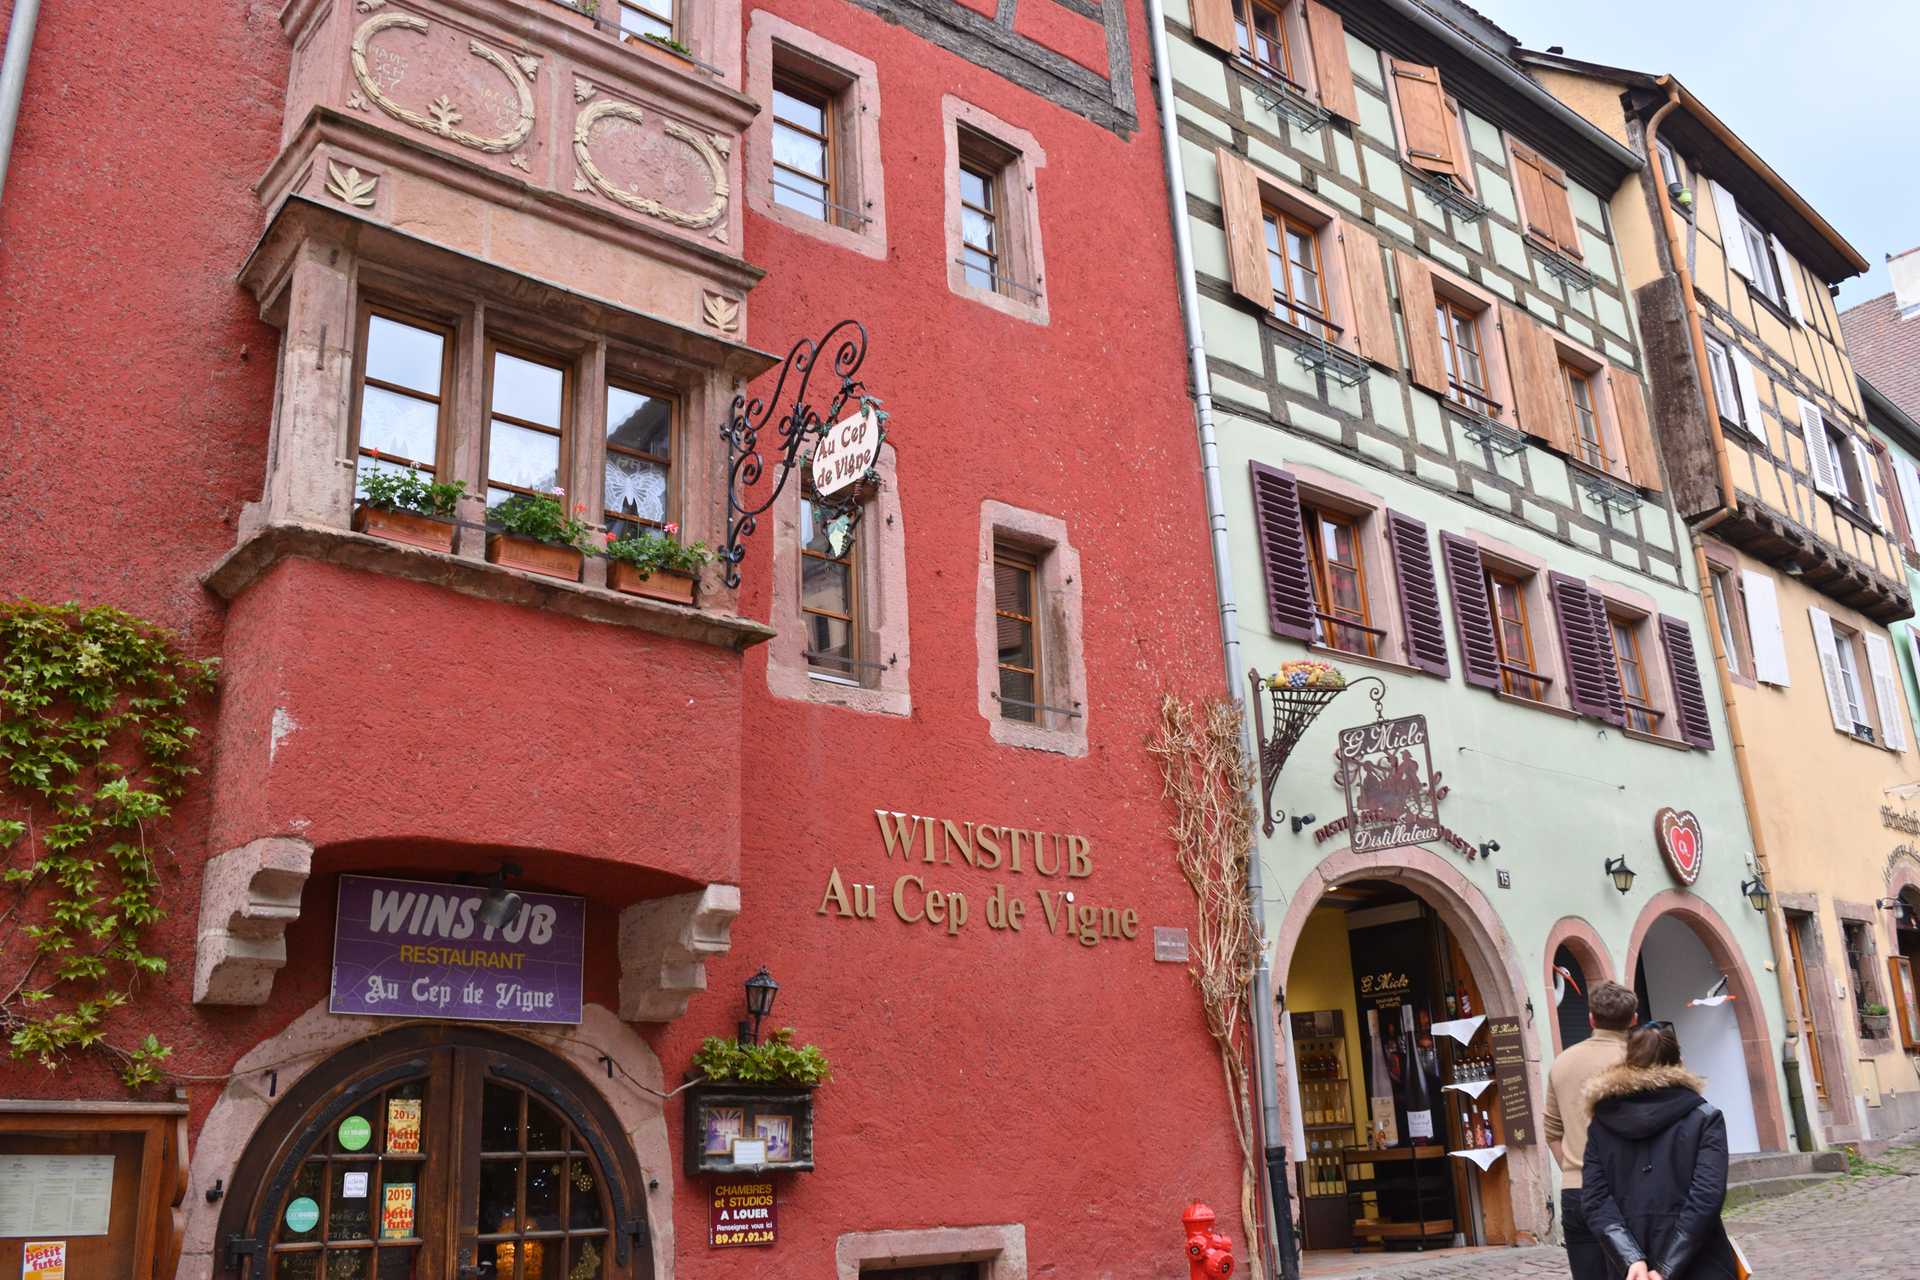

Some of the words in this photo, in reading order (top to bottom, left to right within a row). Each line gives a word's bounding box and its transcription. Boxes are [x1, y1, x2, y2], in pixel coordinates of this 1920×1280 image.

[817, 436, 835, 462] Au
[841, 421, 867, 447] Cep
[817, 467, 832, 488] de
[835, 449, 871, 480] Vigne
[1367, 722, 1424, 753] Miclo
[874, 809, 1094, 878] WINSTUB
[1355, 823, 1439, 850] Distillateur
[1499, 873, 1510, 886] 15
[816, 865, 877, 918] Au
[893, 874, 969, 935] Cep
[986, 884, 1026, 931] de
[1036, 889, 1139, 946] Vigne
[400, 944, 526, 970] RESTAURANT
[365, 975, 399, 1004] Au
[411, 977, 451, 1008] Cep
[463, 982, 484, 1004] de
[496, 983, 554, 1012] Vigne
[388, 1189, 412, 1201] 2019
[714, 1197, 725, 1208] et
[729, 1196, 773, 1207] STUDIOS
[715, 1184, 772, 1196] CHAMBRES
[720, 1209, 730, 1220] A
[733, 1208, 769, 1220] LOUER
